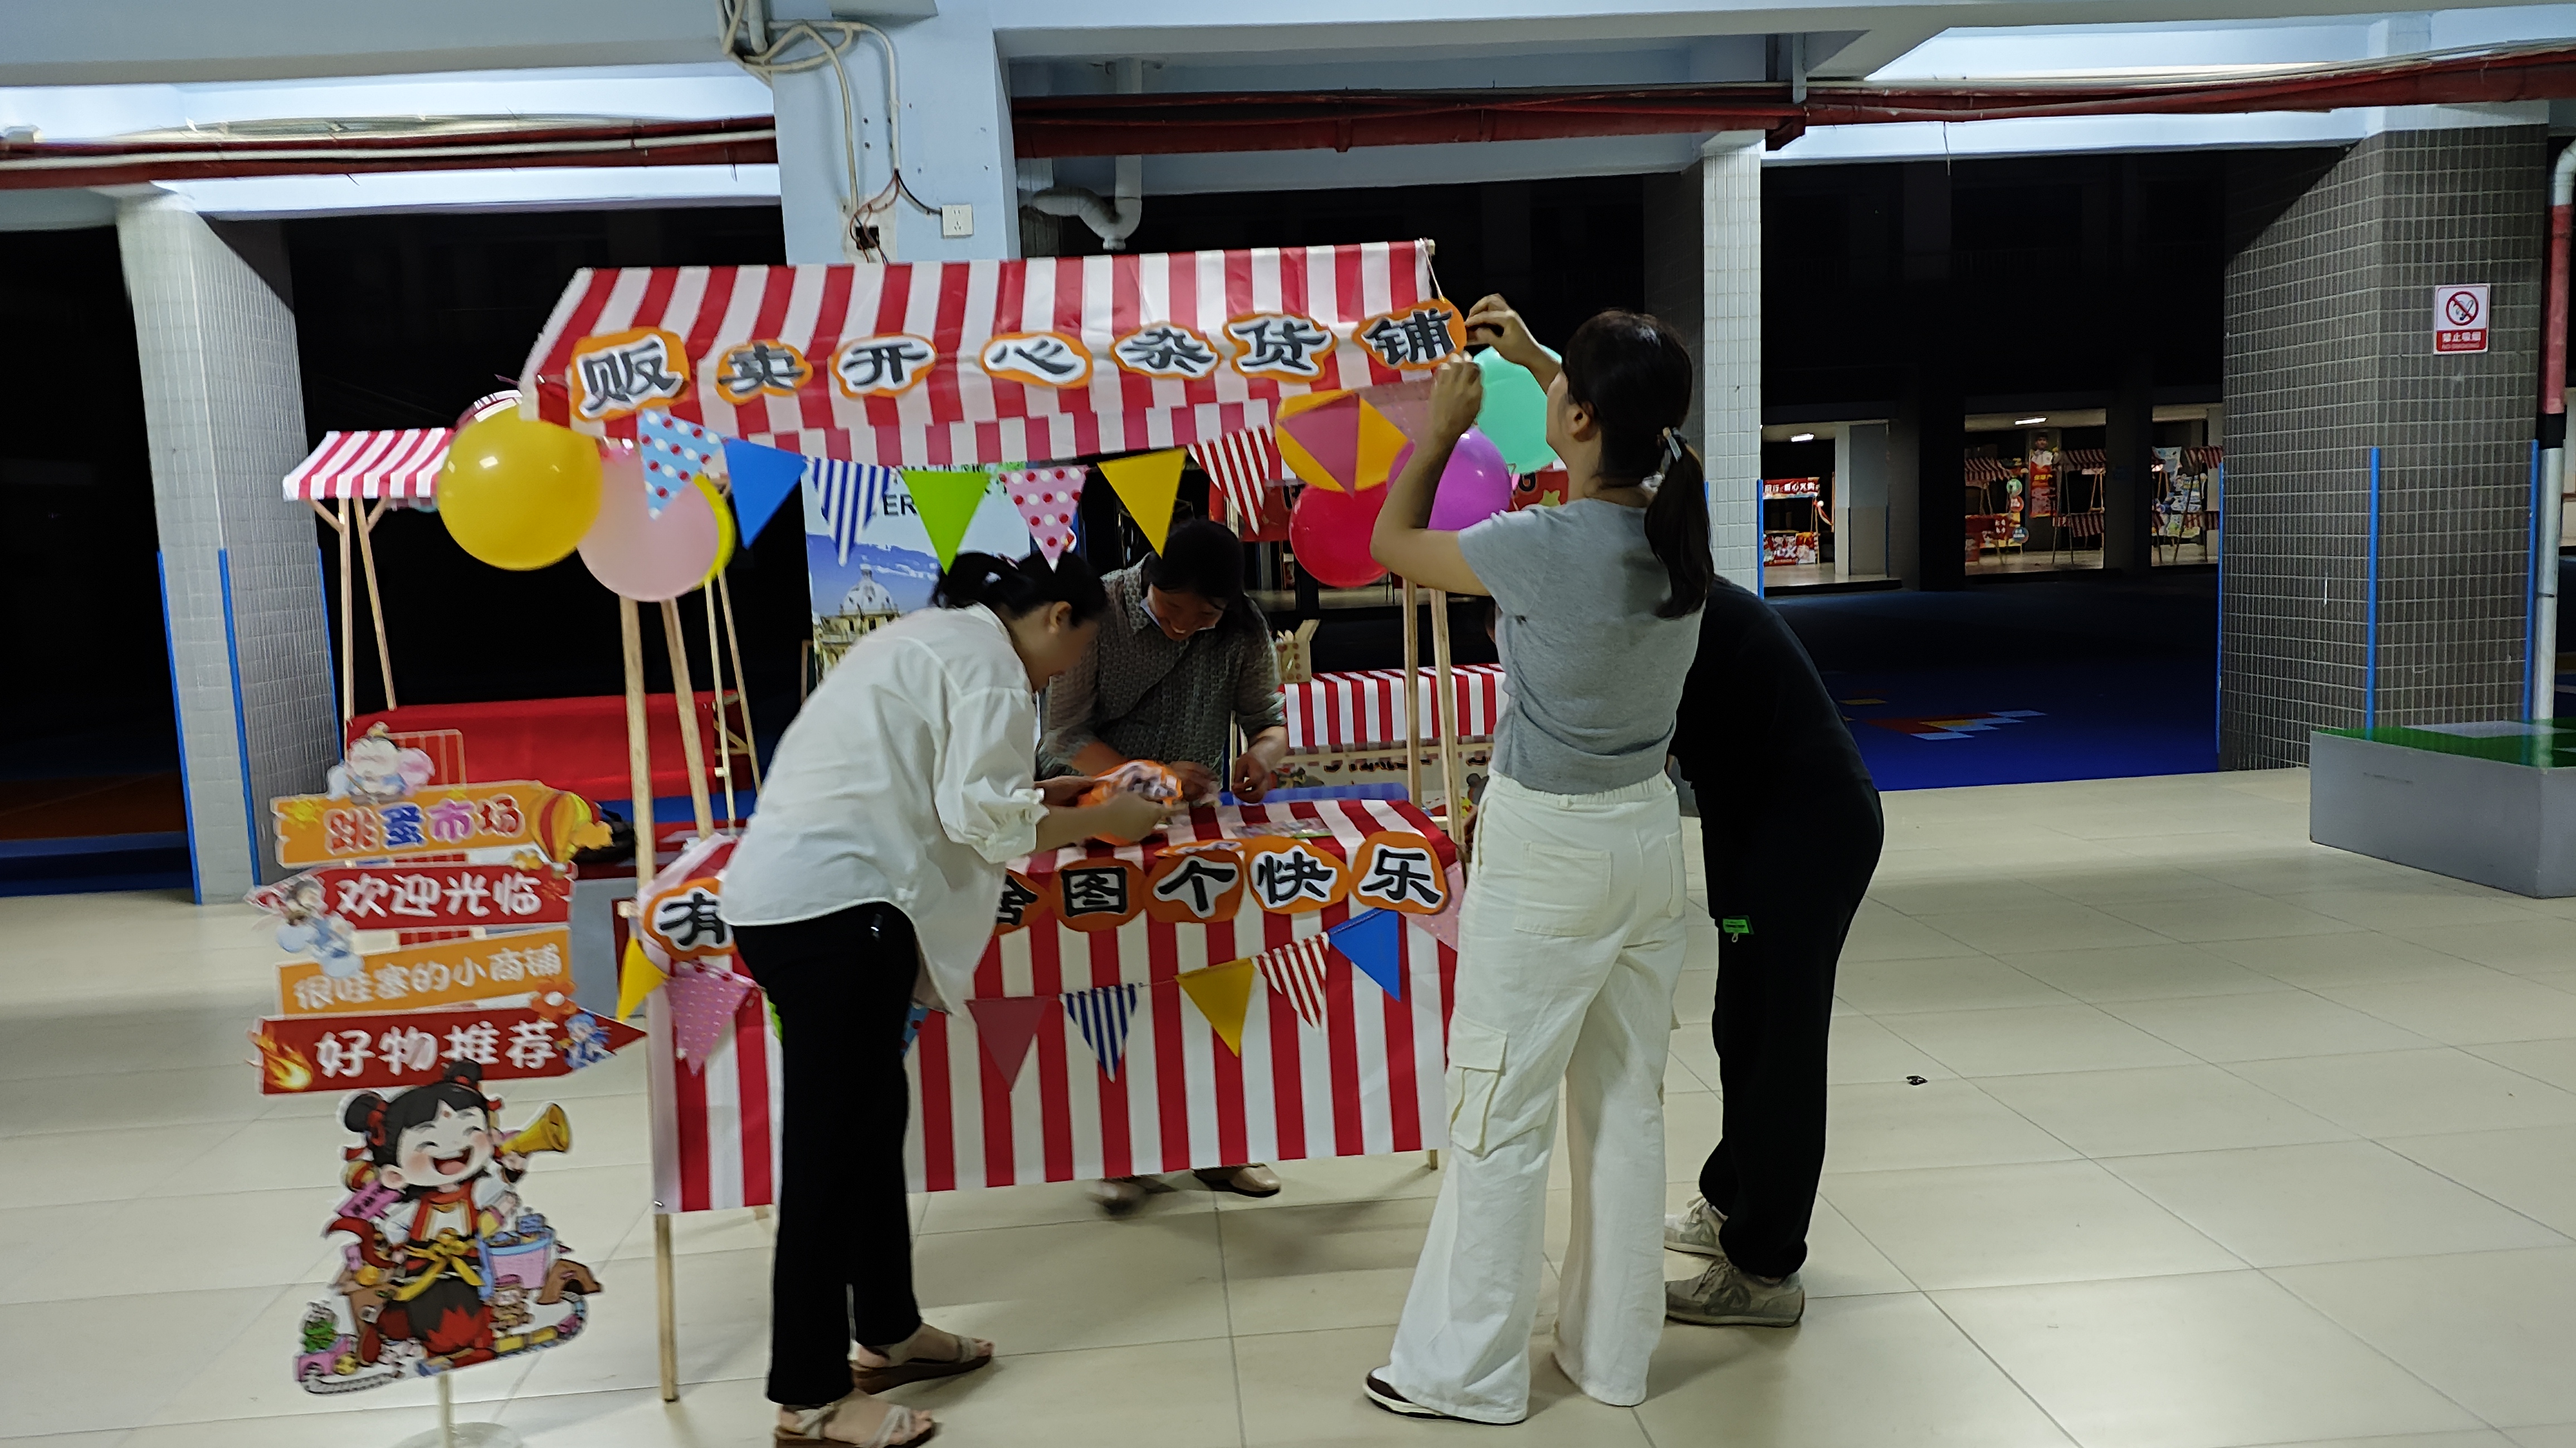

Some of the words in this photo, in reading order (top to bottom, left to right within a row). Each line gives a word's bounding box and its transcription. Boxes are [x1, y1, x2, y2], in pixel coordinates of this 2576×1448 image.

[580, 307, 1454, 411] 贩卖开心杂货铺
[328, 796, 524, 850] 跳蚤市场
[337, 872, 542, 918] 欢迎光临
[294, 943, 562, 1010] 很哇塞的小商铺
[317, 1020, 559, 1076] 好物推荐
